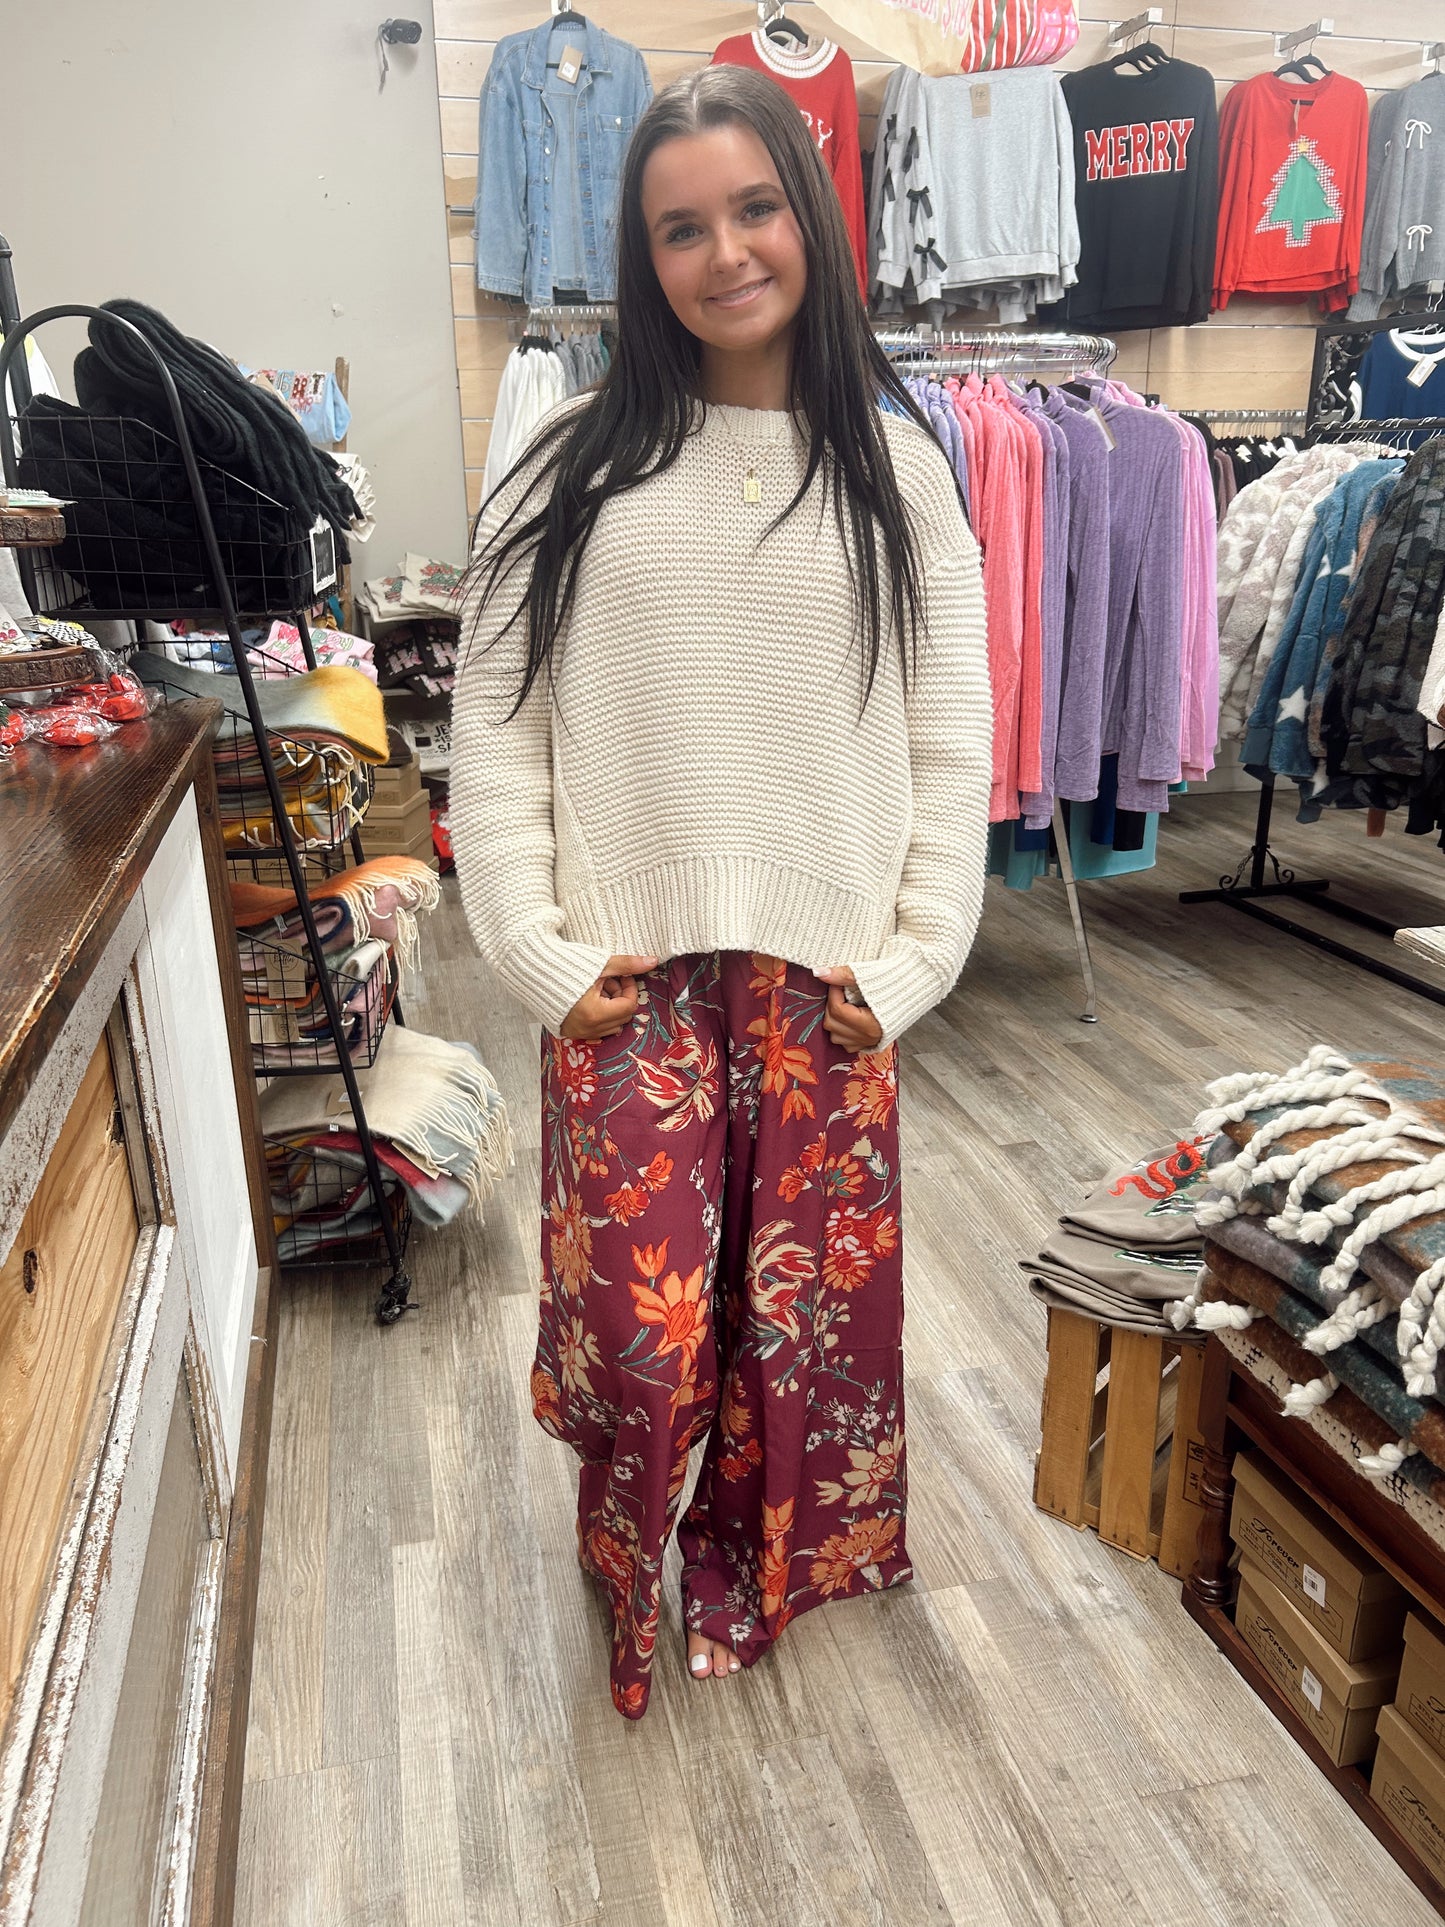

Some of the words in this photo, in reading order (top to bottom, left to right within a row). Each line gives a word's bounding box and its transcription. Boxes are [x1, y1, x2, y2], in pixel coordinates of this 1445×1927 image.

[1085, 118, 1195, 181] MERRY
[1251, 1517, 1299, 1568] Forever
[1256, 1616, 1298, 1671] Forever
